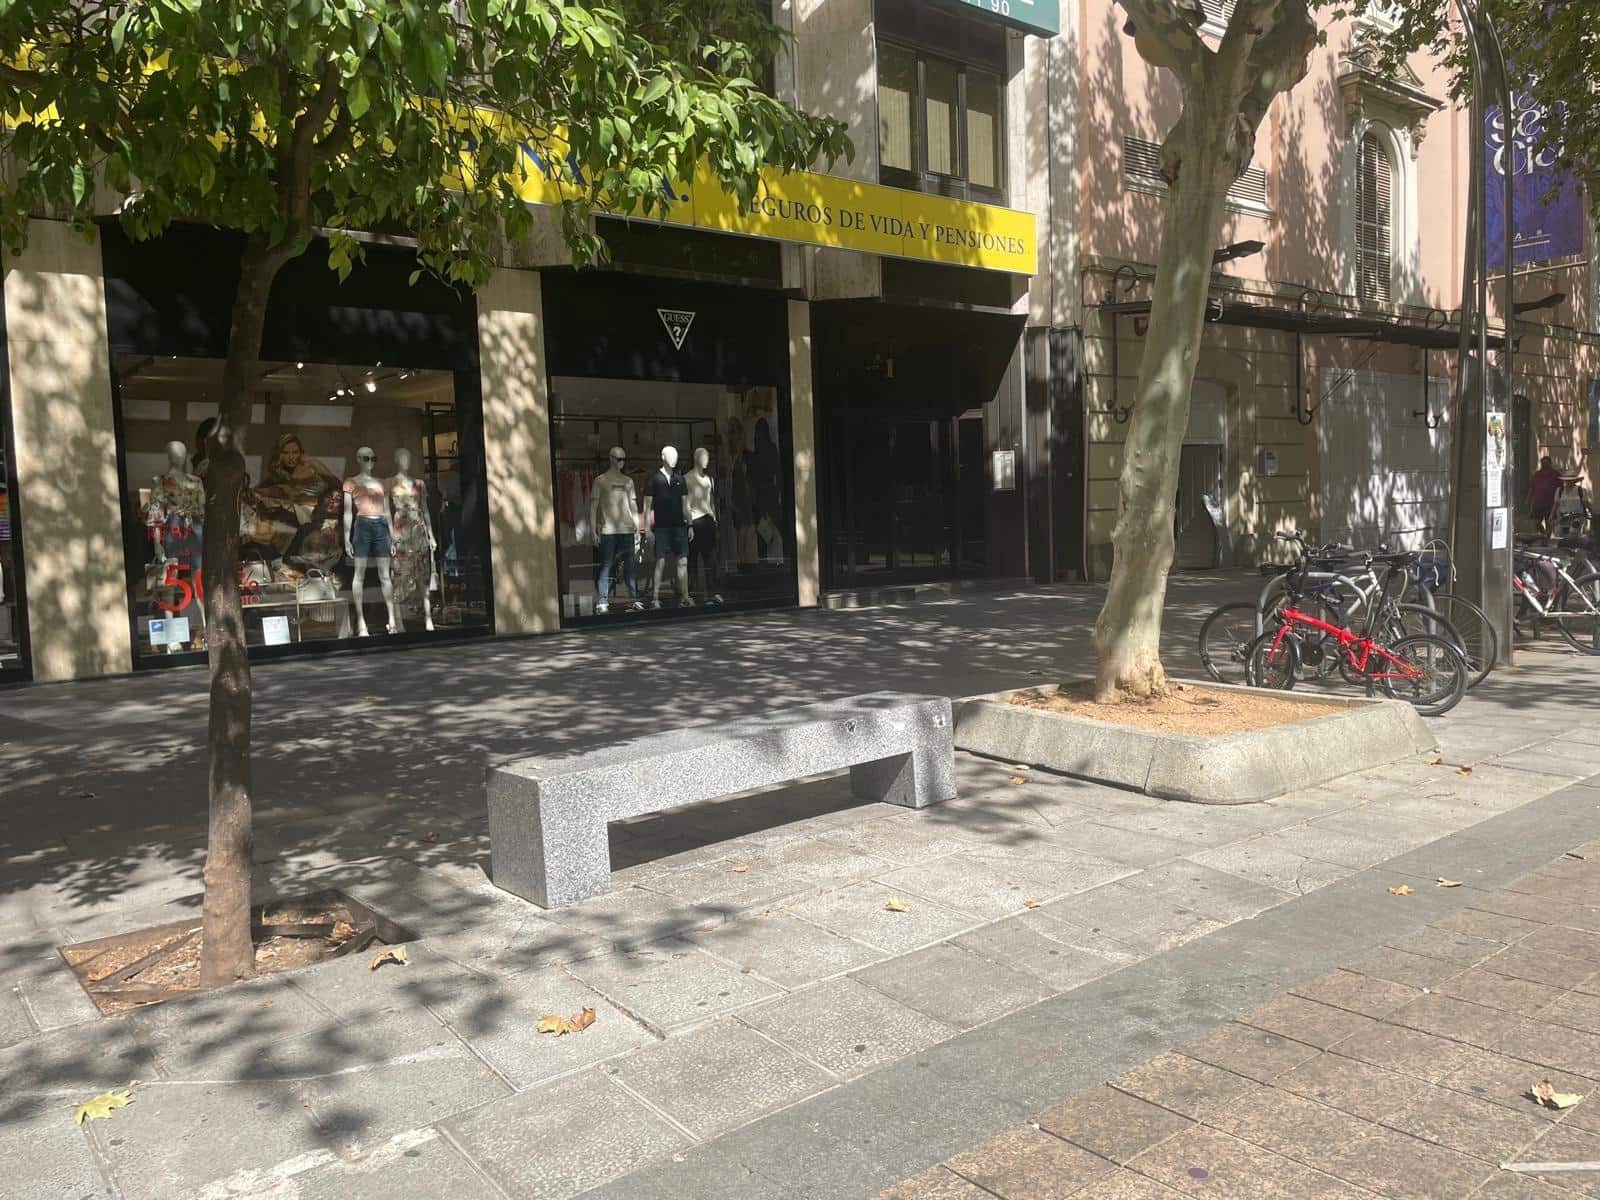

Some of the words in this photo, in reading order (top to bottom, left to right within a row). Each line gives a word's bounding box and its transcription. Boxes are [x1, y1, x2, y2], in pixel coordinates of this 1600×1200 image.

[746, 197, 833, 226] EGUROS
[840, 208, 866, 231] DE
[869, 213, 915, 240] VIDA
[918, 222, 931, 241] Y
[935, 225, 1025, 256] PENSIONES
